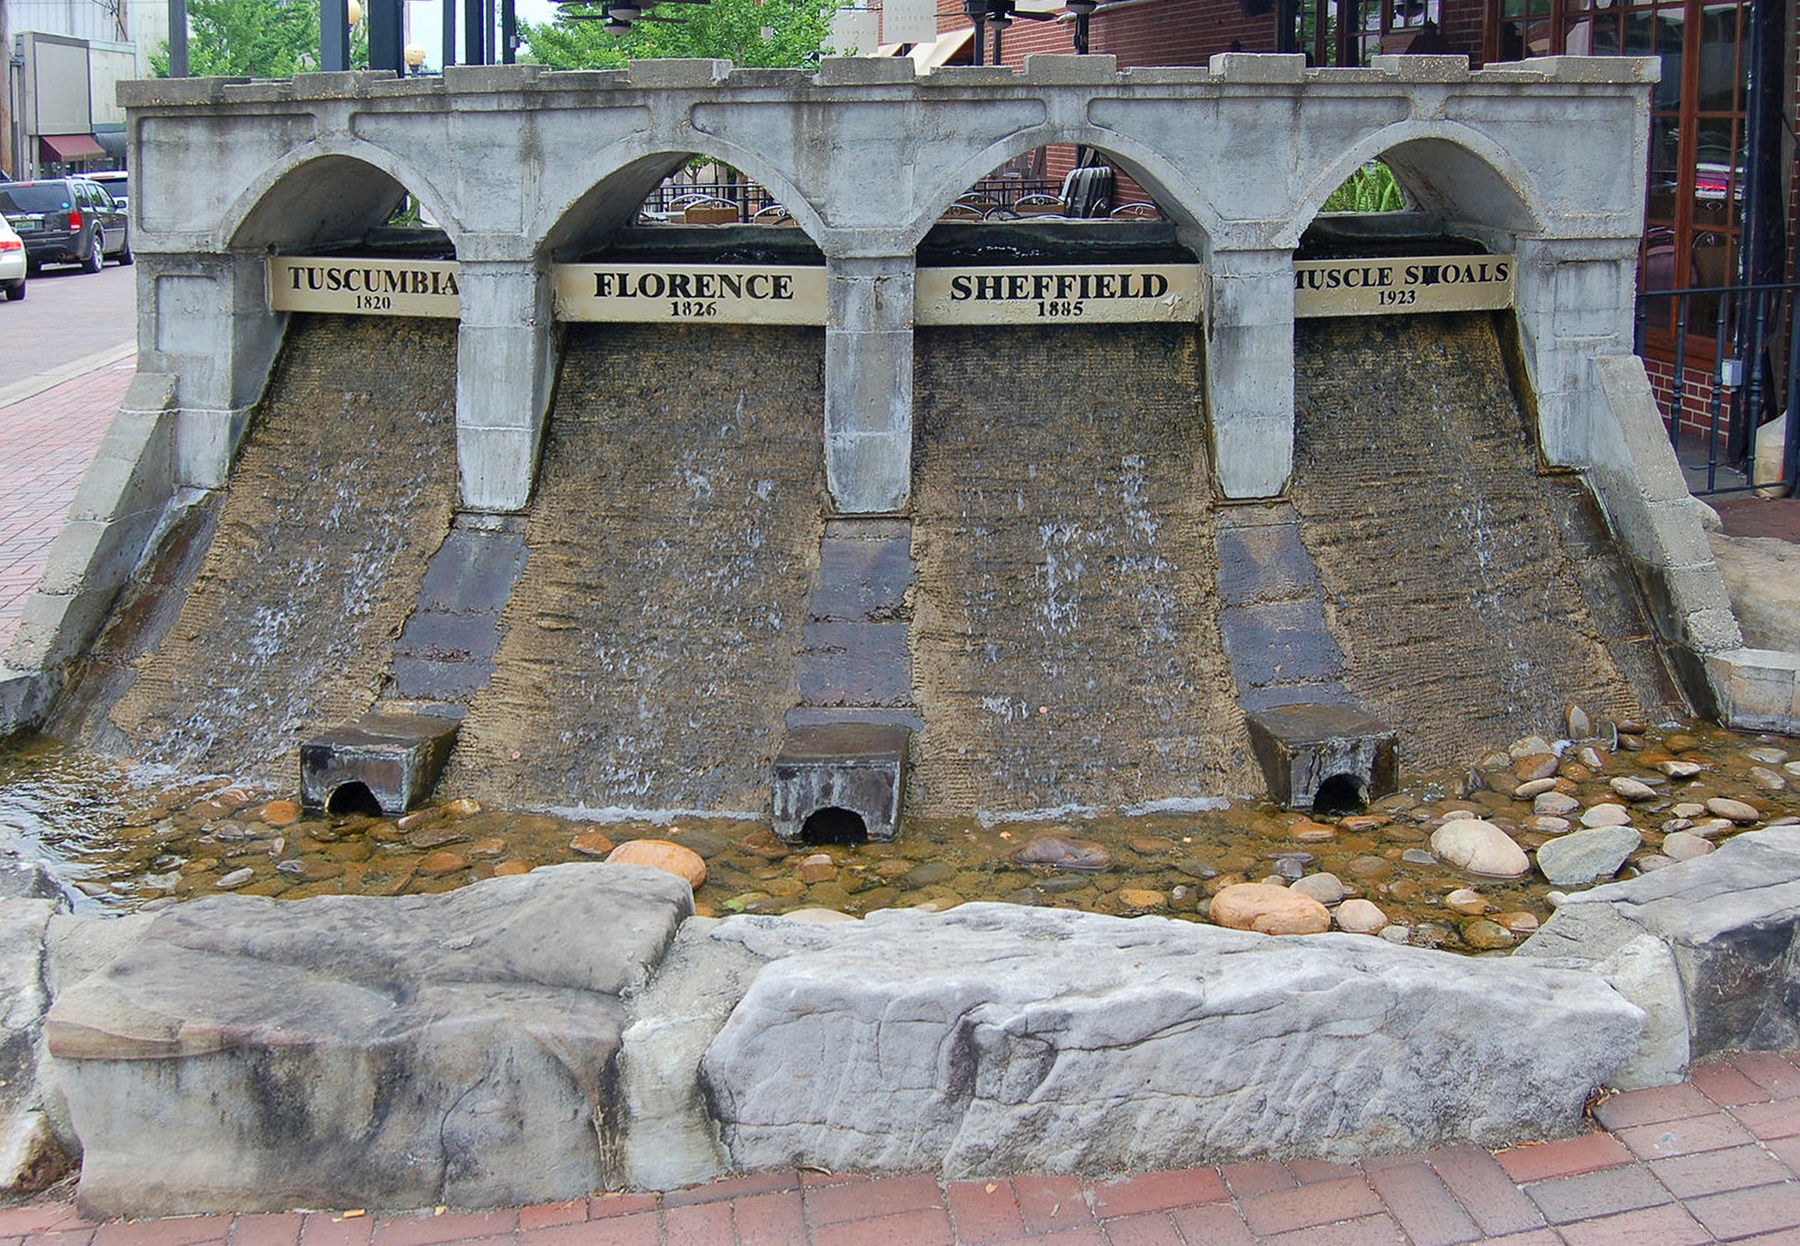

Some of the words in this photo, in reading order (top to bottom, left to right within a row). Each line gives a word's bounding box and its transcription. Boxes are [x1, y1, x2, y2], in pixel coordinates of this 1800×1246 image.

[288, 266, 460, 295] TUSCUMBIA
[1404, 262, 1509, 287] SHOALS
[594, 272, 794, 300] FLORENCE
[951, 273, 1168, 300] SHEFFIELD
[356, 295, 391, 310] 1820
[1378, 290, 1416, 306] 1923
[670, 301, 717, 317] 1826
[1037, 301, 1084, 317] 1885
